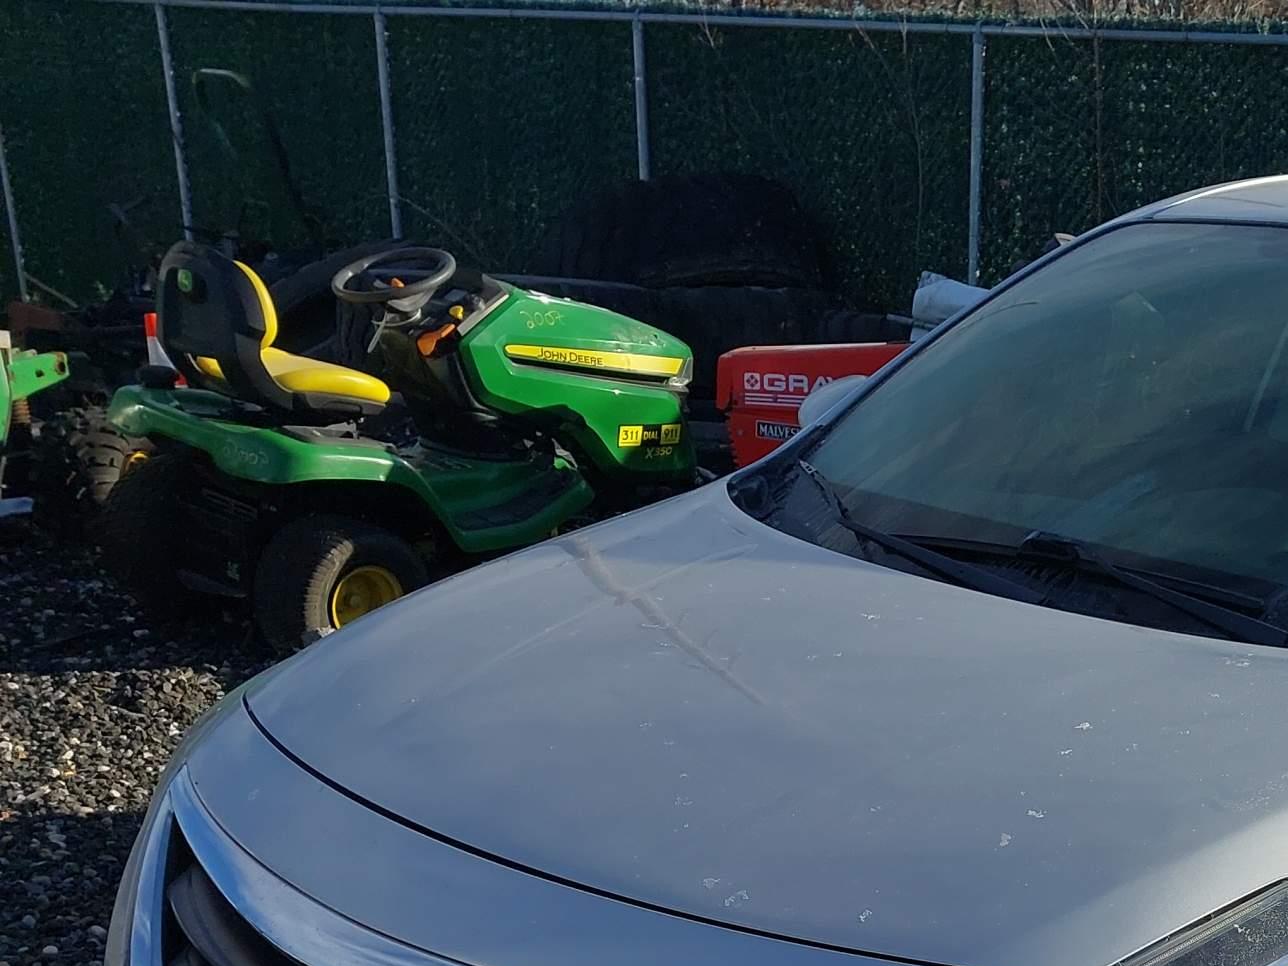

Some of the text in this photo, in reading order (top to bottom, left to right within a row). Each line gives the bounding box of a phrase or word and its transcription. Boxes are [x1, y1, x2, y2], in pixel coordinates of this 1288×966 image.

[538, 347, 604, 366] JOHN DEERE
[763, 373, 833, 393] GRA
[621, 427, 679, 442] 311 DIAL 911
